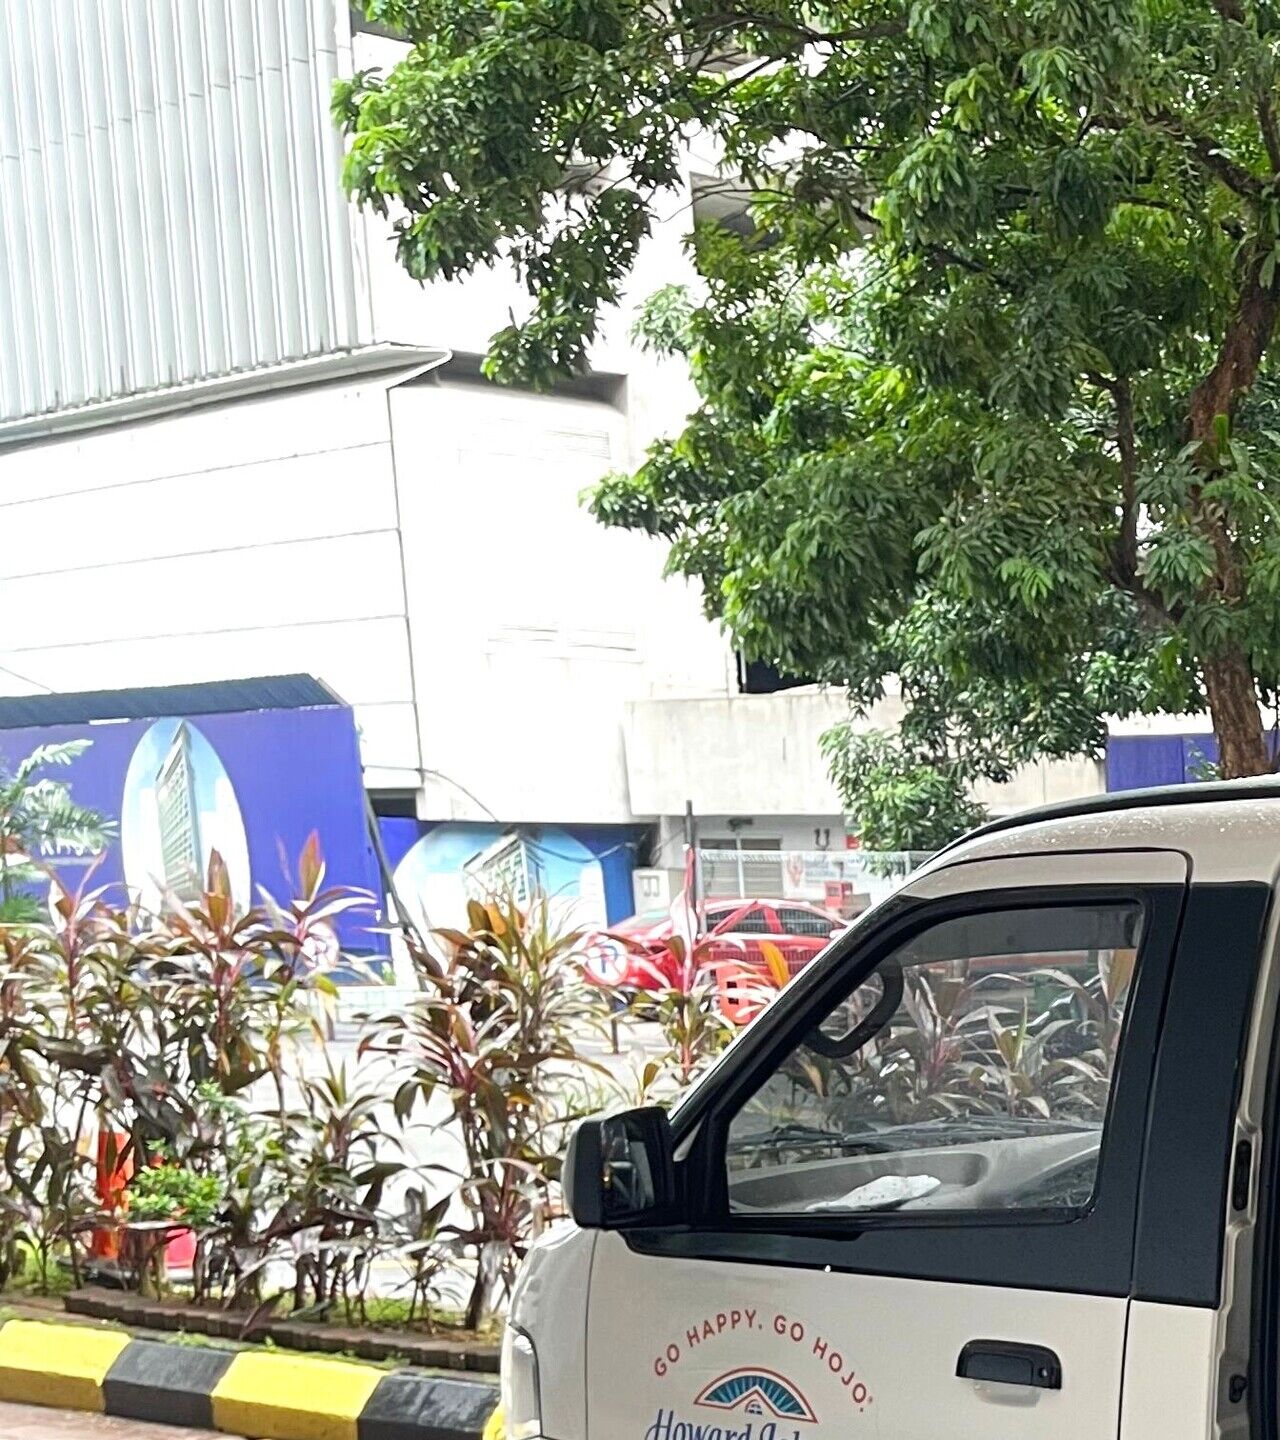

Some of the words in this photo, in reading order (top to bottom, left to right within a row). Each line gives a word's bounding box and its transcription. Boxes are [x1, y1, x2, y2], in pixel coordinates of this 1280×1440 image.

[654, 1343, 680, 1377] GO
[686, 1309, 763, 1348] HAPPY.
[773, 1314, 804, 1342] GO
